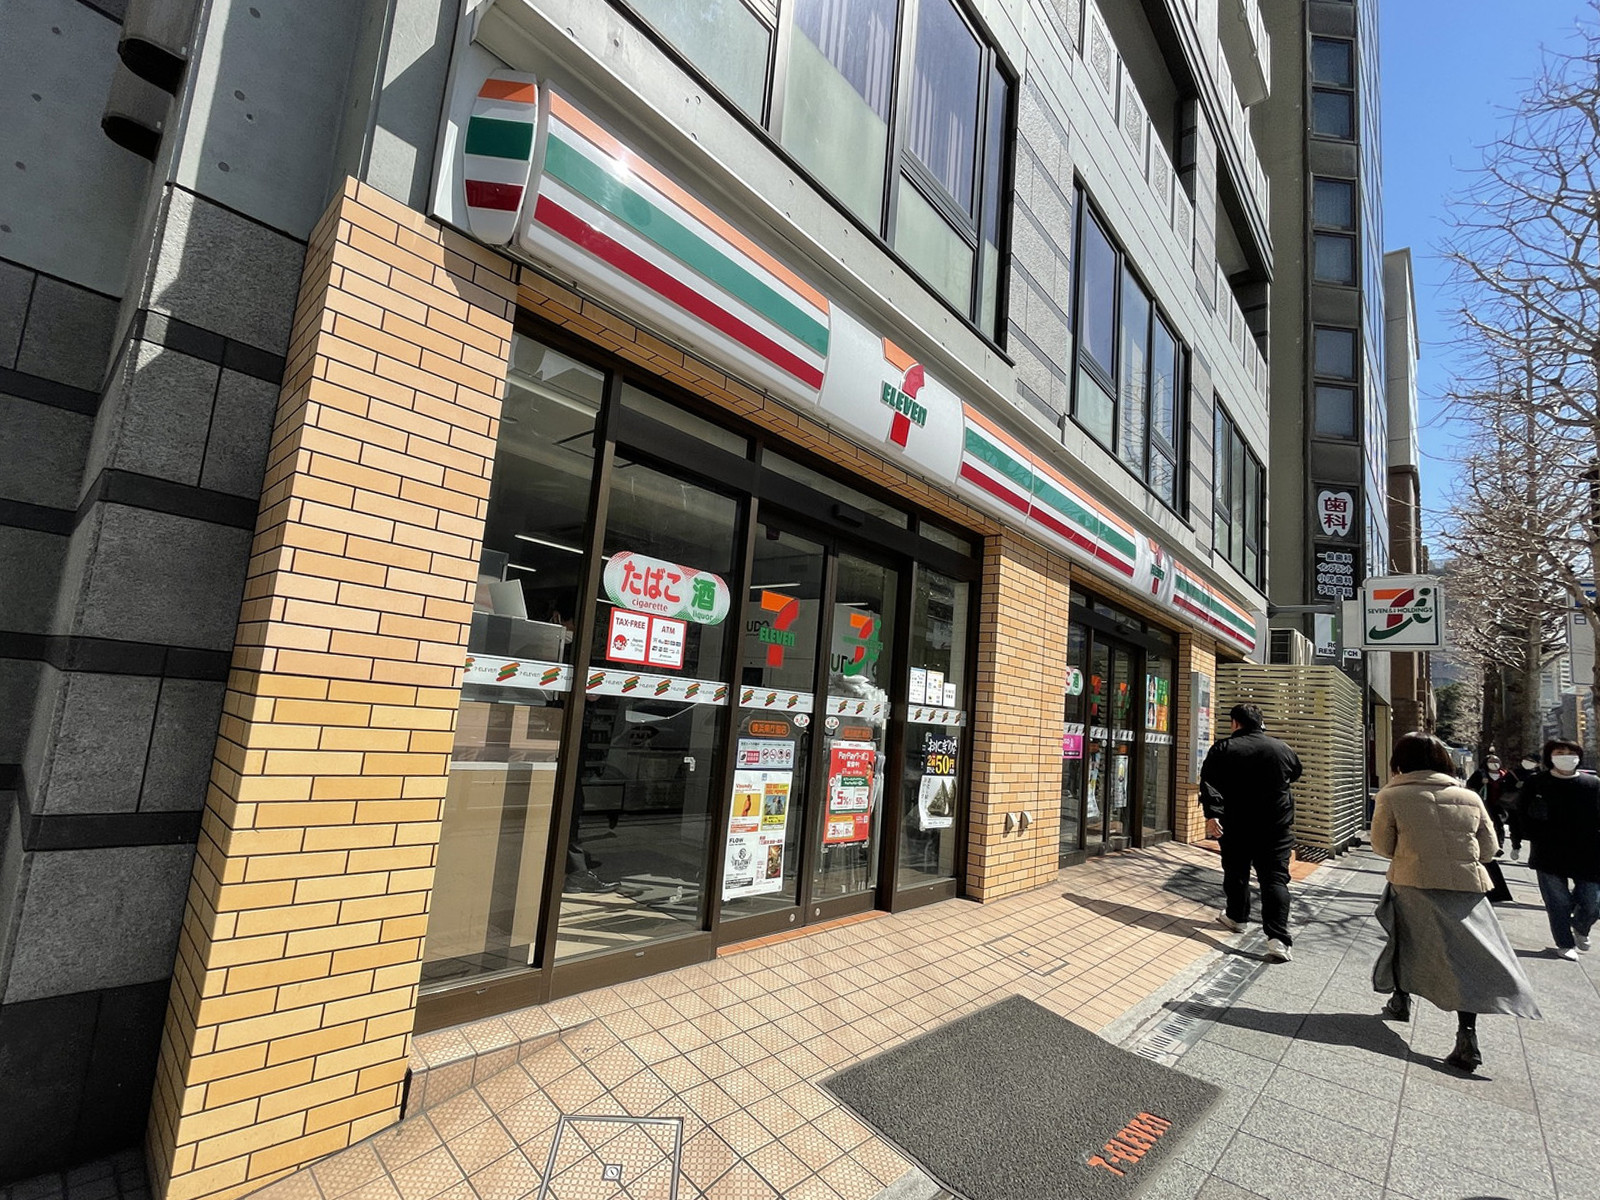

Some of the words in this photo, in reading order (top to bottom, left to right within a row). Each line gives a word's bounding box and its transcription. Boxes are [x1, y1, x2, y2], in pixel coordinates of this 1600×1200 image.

[1323, 497, 1348, 530] 歯科
[1317, 552, 1352, 563] 一般歯科
[1317, 563, 1353, 574] インプラント
[621, 561, 681, 602] たばこ
[1317, 574, 1352, 586] 小児歯科
[691, 577, 717, 612] 酒
[631, 597, 669, 613] cigarette
[1397, 606, 1434, 614] HOLDINGS
[616, 617, 645, 629] TAX-FREE
[660, 625, 676, 635] ATM
